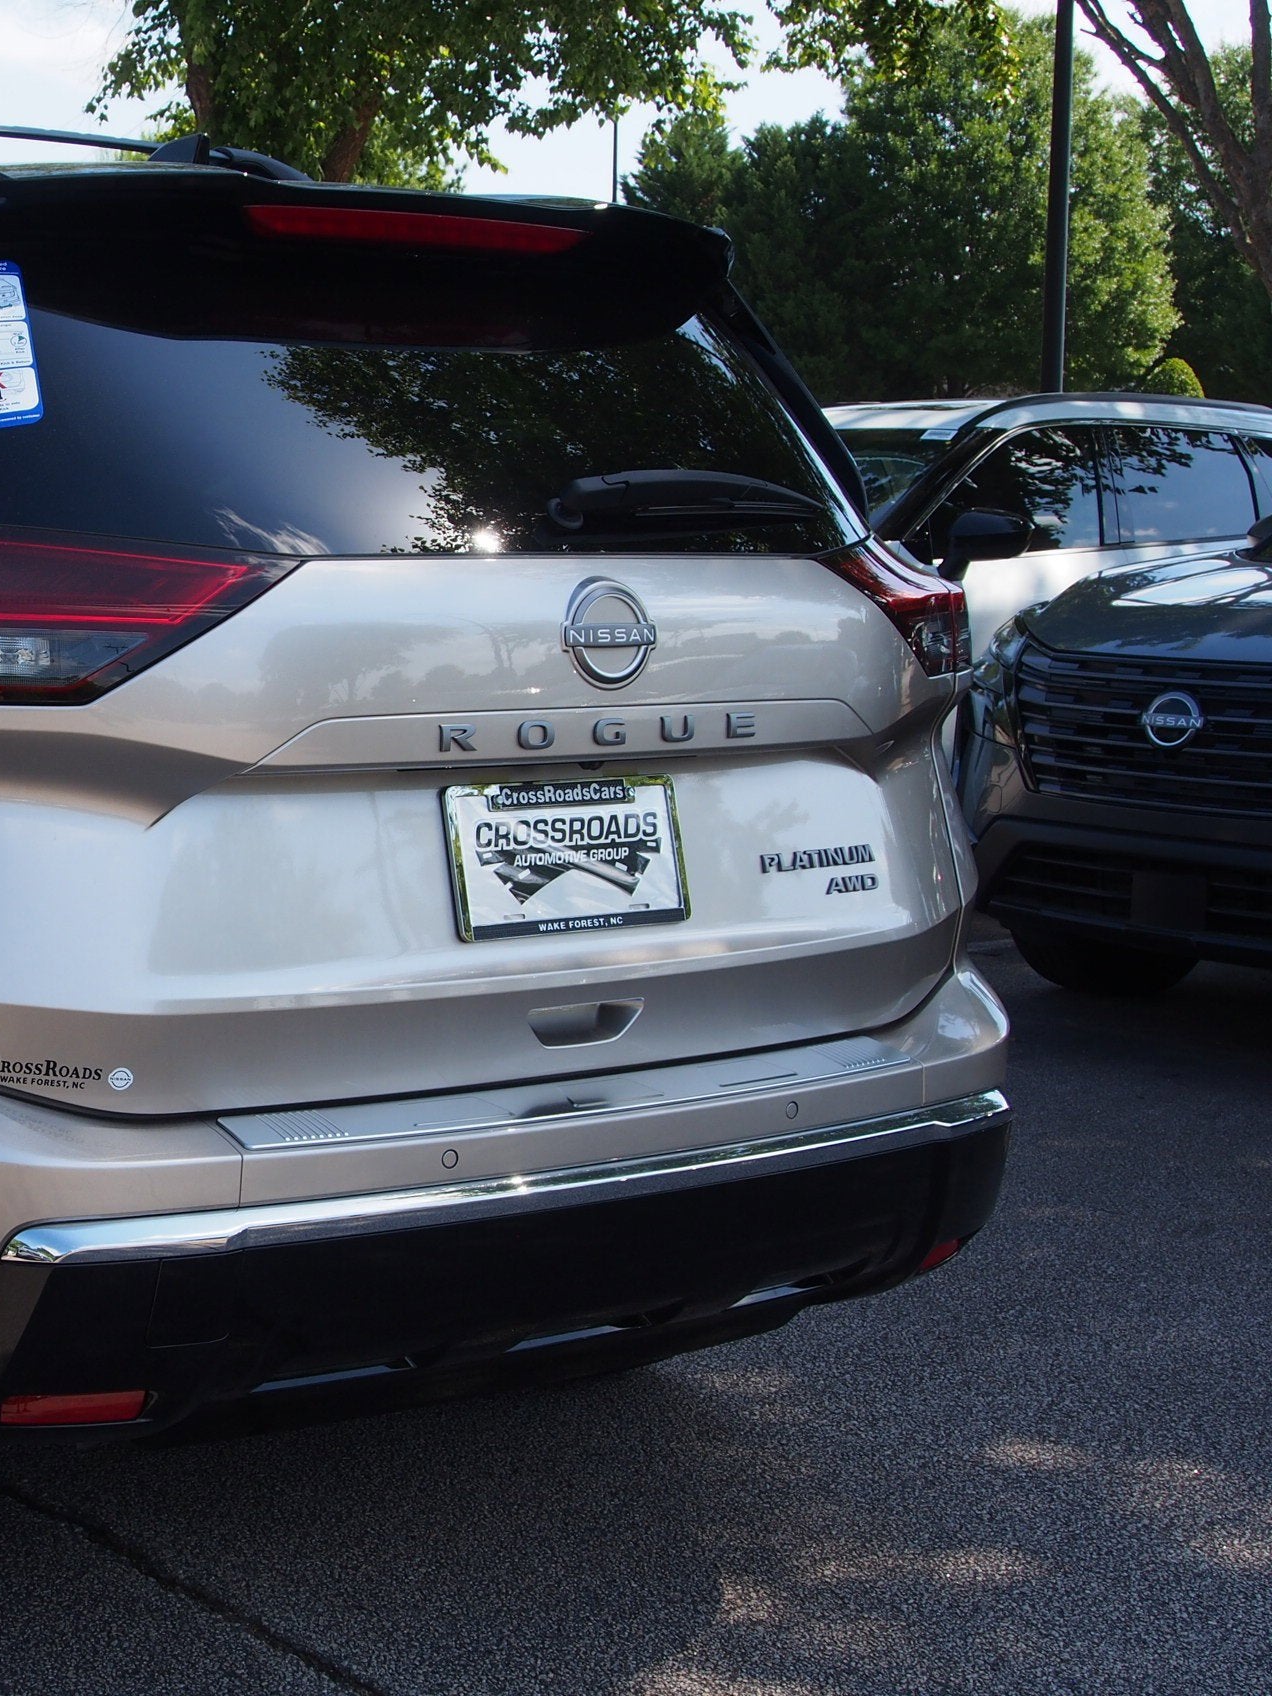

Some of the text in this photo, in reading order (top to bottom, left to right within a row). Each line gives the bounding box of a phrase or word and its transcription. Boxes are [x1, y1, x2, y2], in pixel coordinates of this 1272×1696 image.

[569, 628, 655, 643] NISSAN
[1142, 715, 1201, 727] NISSAN
[439, 712, 756, 752] ROGUE
[502, 782, 624, 806] CrossRoadsCars
[475, 811, 658, 849] CROSSROADS
[513, 847, 629, 867] AUTOMOTIVE GROUP
[760, 844, 876, 874] PLATINUM
[825, 873, 879, 895] AWD
[538, 916, 624, 932] WAKE FOREST, NC
[0, 1075, 85, 1090] WAKE FOREST, NC
